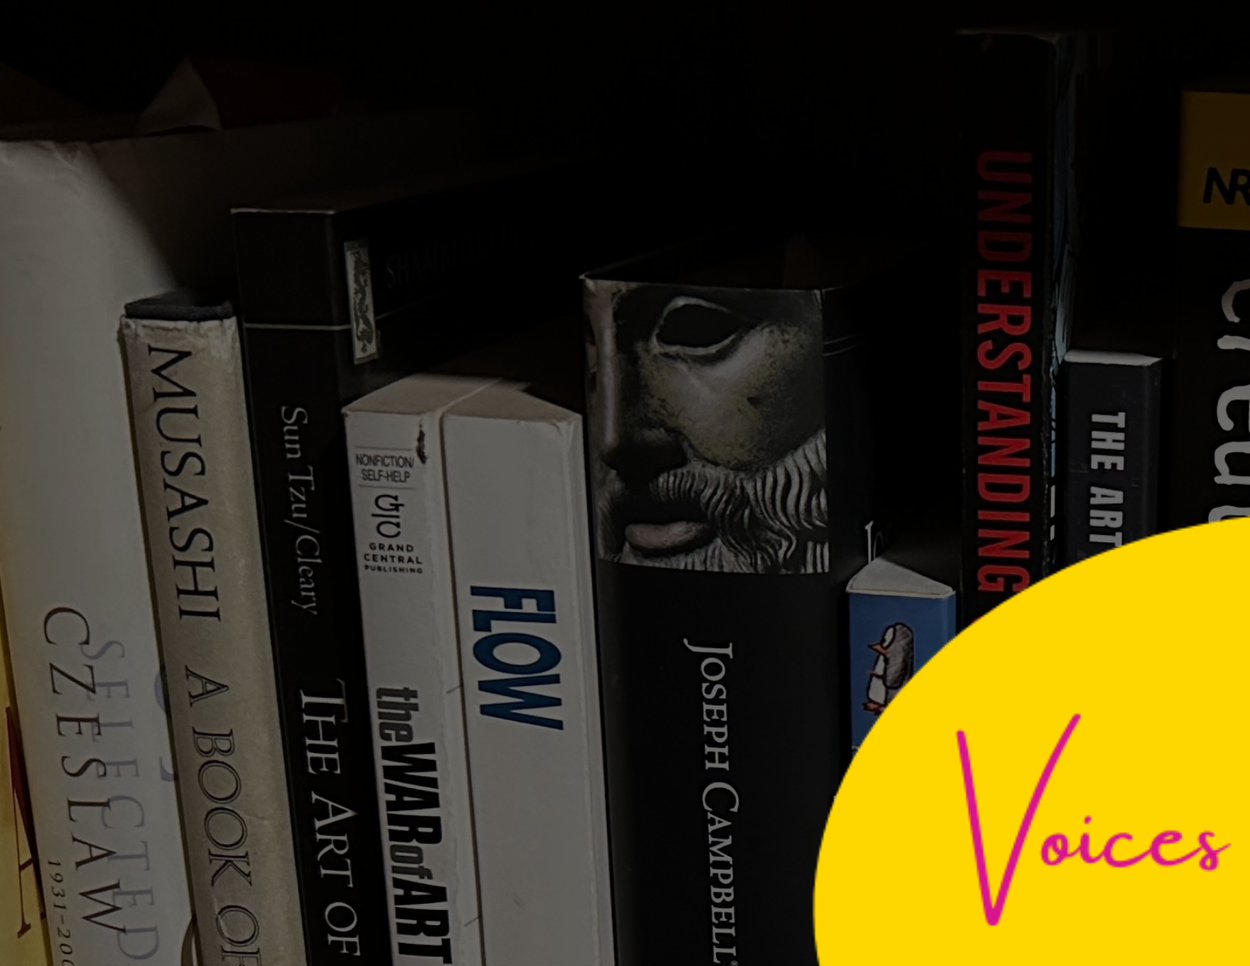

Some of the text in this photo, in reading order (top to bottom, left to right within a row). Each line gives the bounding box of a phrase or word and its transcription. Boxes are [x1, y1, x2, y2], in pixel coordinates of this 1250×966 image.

[977, 150, 1032, 593] UNDERSTANDING
[279, 404, 324, 616] Sun Tzu/Cleary
[361, 469, 411, 483] SELF-HELP
[1088, 410, 1126, 547] THE ART
[364, 553, 423, 565] CENTRAL
[364, 564, 423, 574] PUBLISHING
[369, 542, 415, 553] GRAND
[147, 344, 221, 621] MUSASHI
[193, 727, 253, 888] BOOK
[470, 585, 565, 731] FLOW
[43, 606, 127, 935] CZESLAW
[300, 678, 349, 778] THE
[682, 636, 735, 772] JOSEPH
[81, 640, 161, 962] SELECTED
[311, 792, 362, 889] ART
[323, 902, 362, 958] OF
